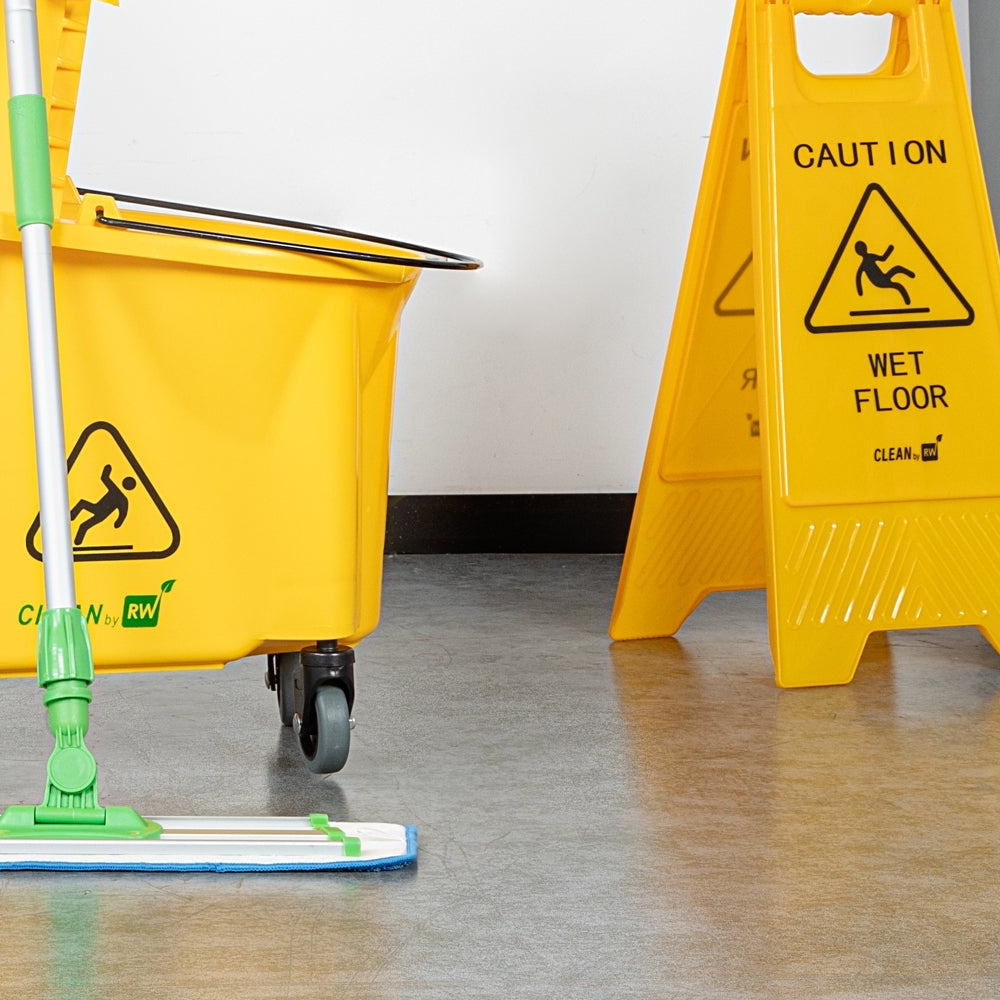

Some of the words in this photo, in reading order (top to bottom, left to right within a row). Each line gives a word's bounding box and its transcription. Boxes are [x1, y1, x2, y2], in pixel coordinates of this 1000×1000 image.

[793, 139, 948, 169] CAUTION
[868, 351, 924, 377] WET
[854, 384, 949, 413] FLOOR
[874, 446, 912, 462] CLEAN
[104, 614, 120, 628] by
[127, 598, 160, 620] RW
